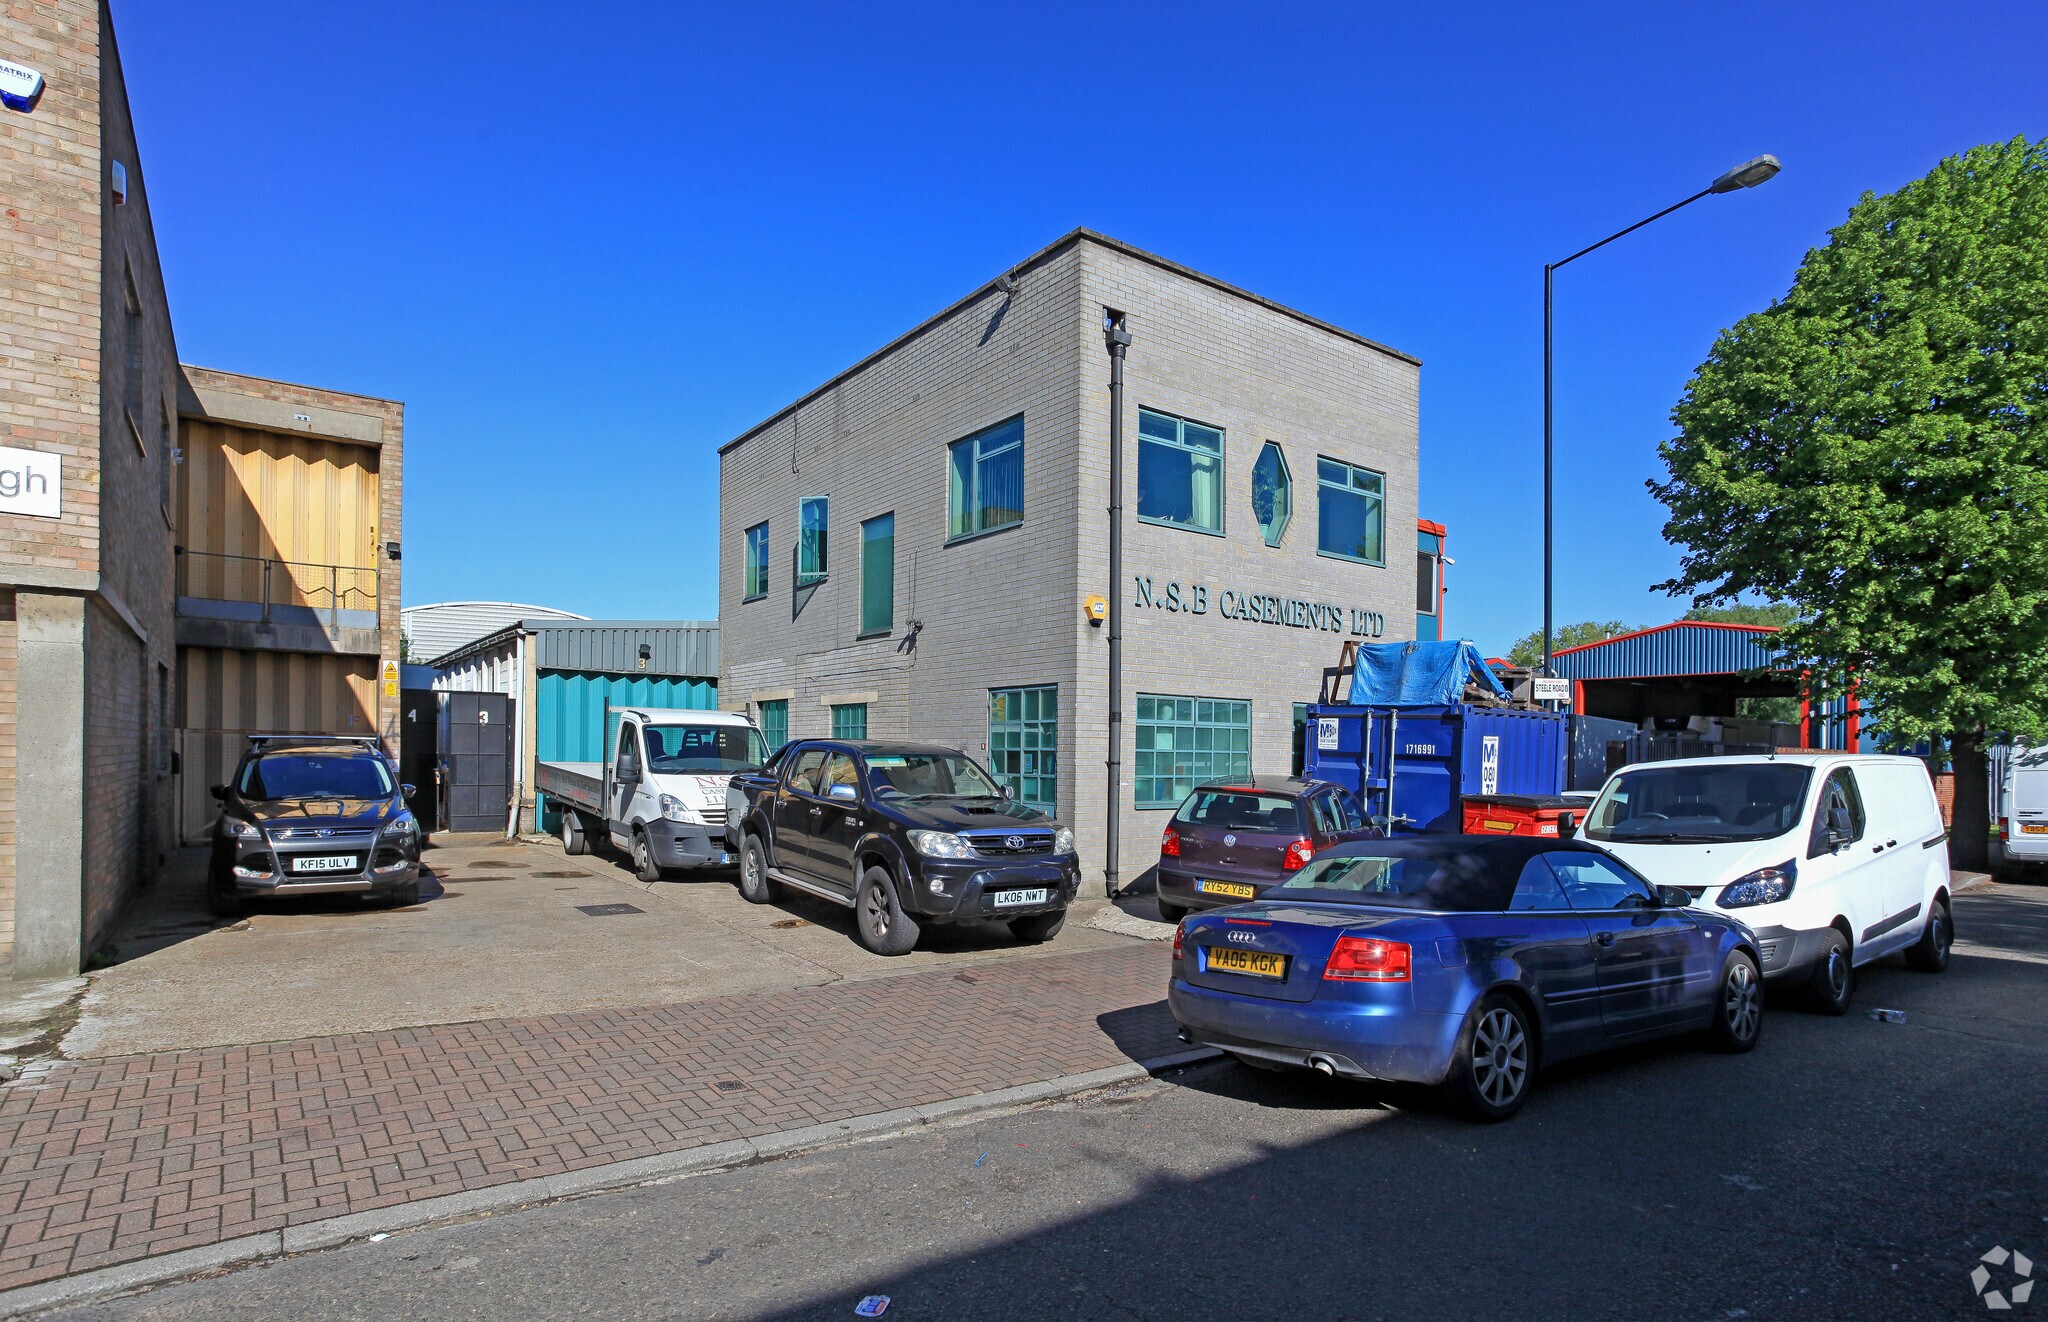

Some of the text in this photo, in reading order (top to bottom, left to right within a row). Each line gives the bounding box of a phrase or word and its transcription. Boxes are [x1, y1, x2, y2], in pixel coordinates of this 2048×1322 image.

[1219, 589, 1343, 633] CASEMENTS
[1350, 609, 1386, 638] LTD
[638, 658, 646, 669] 3
[1536, 684, 1551, 692] STEELE
[408, 709, 417, 722] 4
[479, 711, 489, 724] 3
[1406, 744, 1435, 755] 1716991
[301, 858, 350, 869] KF15 ULV
[1203, 881, 1252, 896] RY52 YBS
[997, 890, 1044, 903] LK06 NWT
[1215, 948, 1279, 973] VA06 KGK
